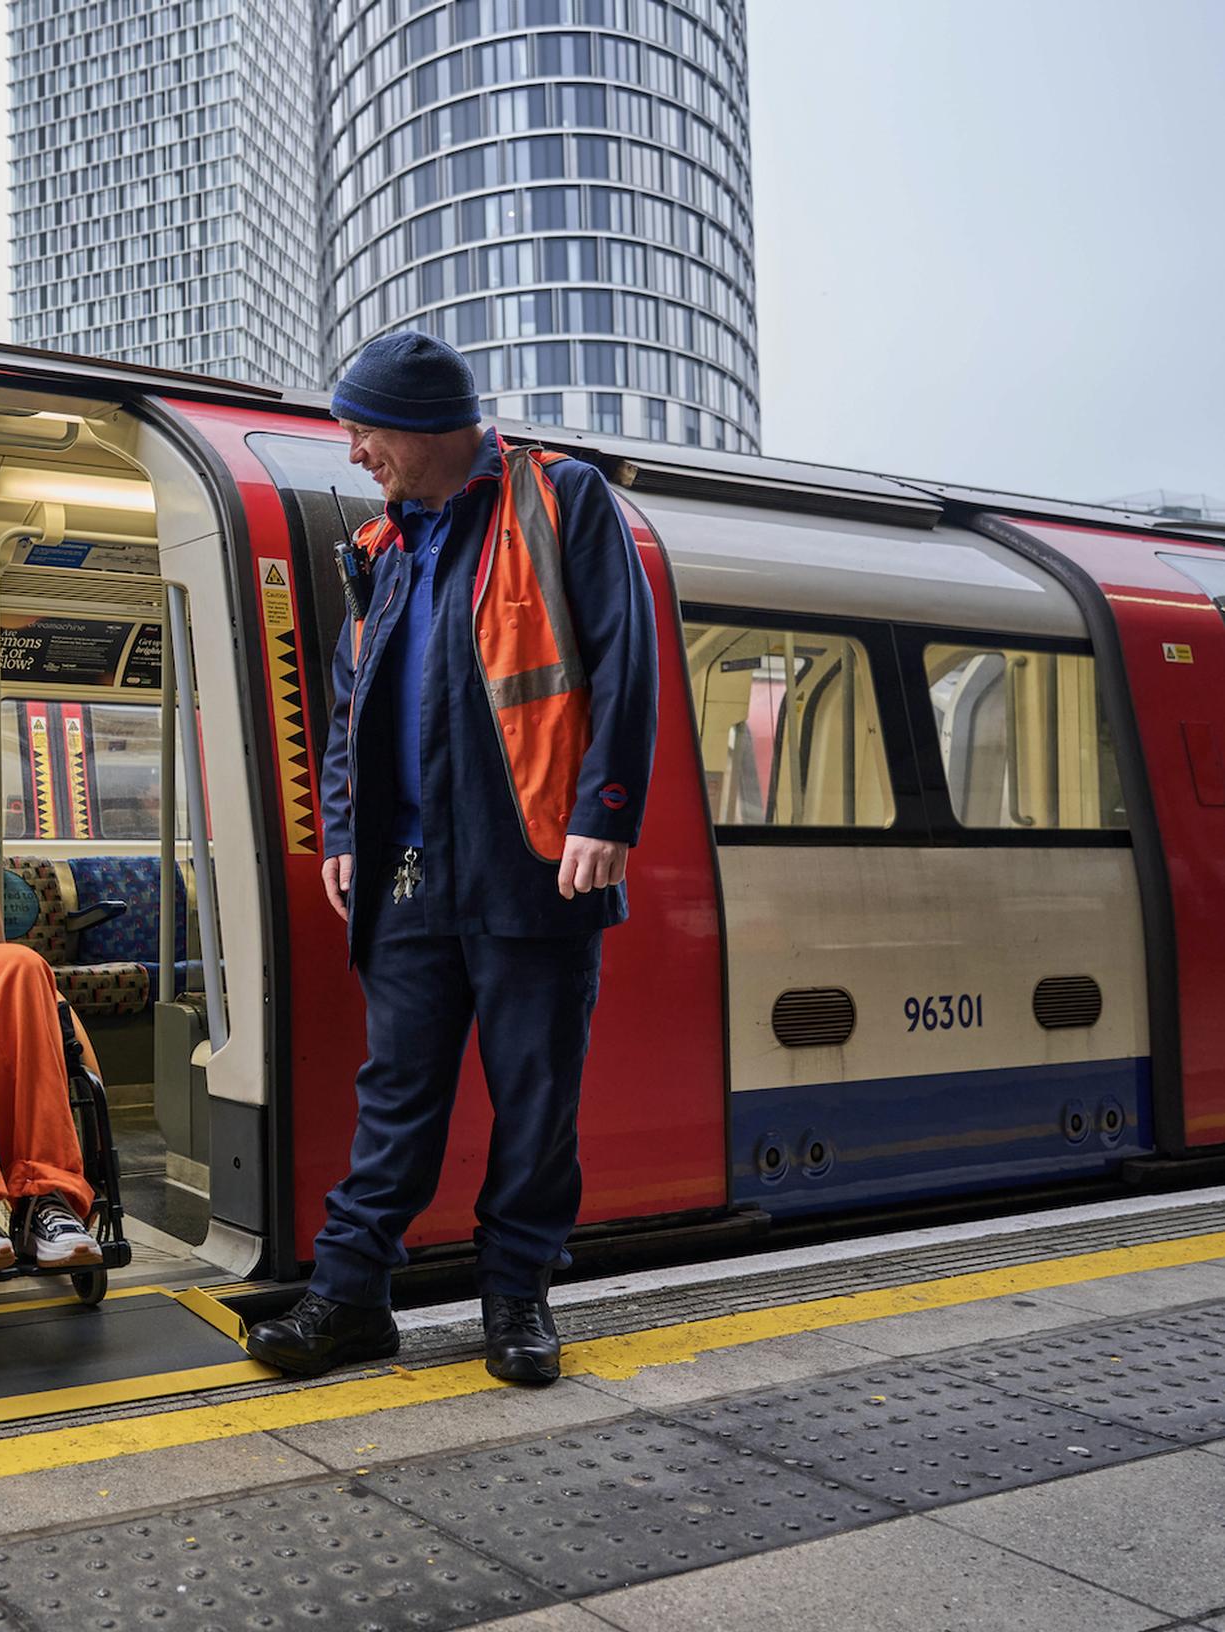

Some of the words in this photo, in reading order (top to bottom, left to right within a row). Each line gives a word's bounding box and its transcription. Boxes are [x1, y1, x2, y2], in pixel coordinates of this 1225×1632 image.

[2, 629, 17, 637] Are
[0, 636, 42, 649] emons
[9, 648, 26, 659] or
[10, 902, 30, 912] this
[904, 993, 982, 1032] 96301
